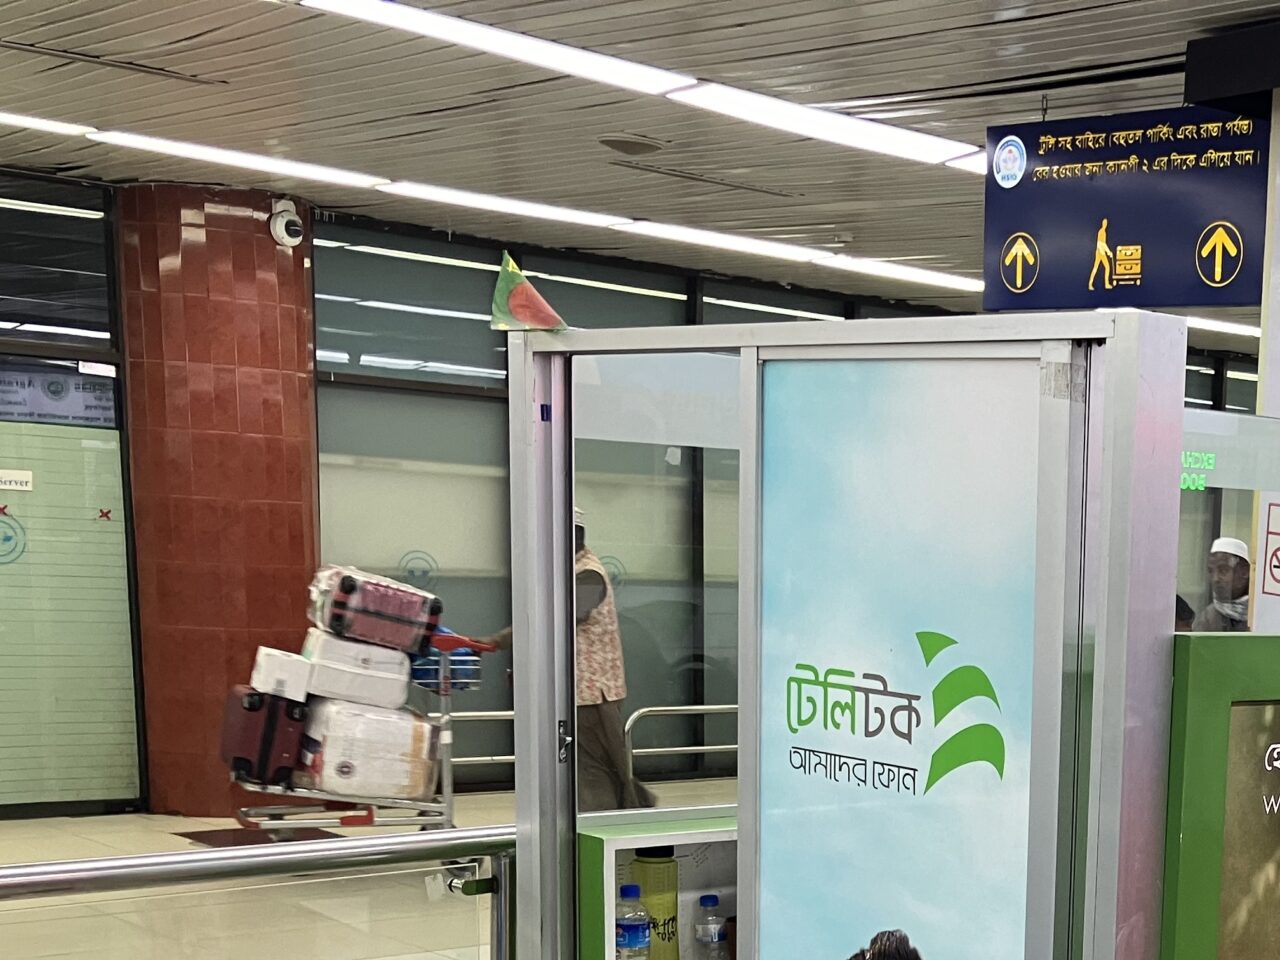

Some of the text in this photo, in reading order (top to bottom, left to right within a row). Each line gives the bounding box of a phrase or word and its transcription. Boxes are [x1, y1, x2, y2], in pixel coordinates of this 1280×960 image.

[1058, 137, 1072, 151] সহ
[1075, 131, 1106, 149] বাহিরে
[1176, 128, 1198, 140] এবং
[1152, 156, 1167, 171] এর
[1170, 151, 1197, 170] দিকে
[1199, 149, 1231, 168] এগিয়ে
[787, 663, 922, 745] টেলিটক
[789, 746, 918, 796] আমাদের ফোন
